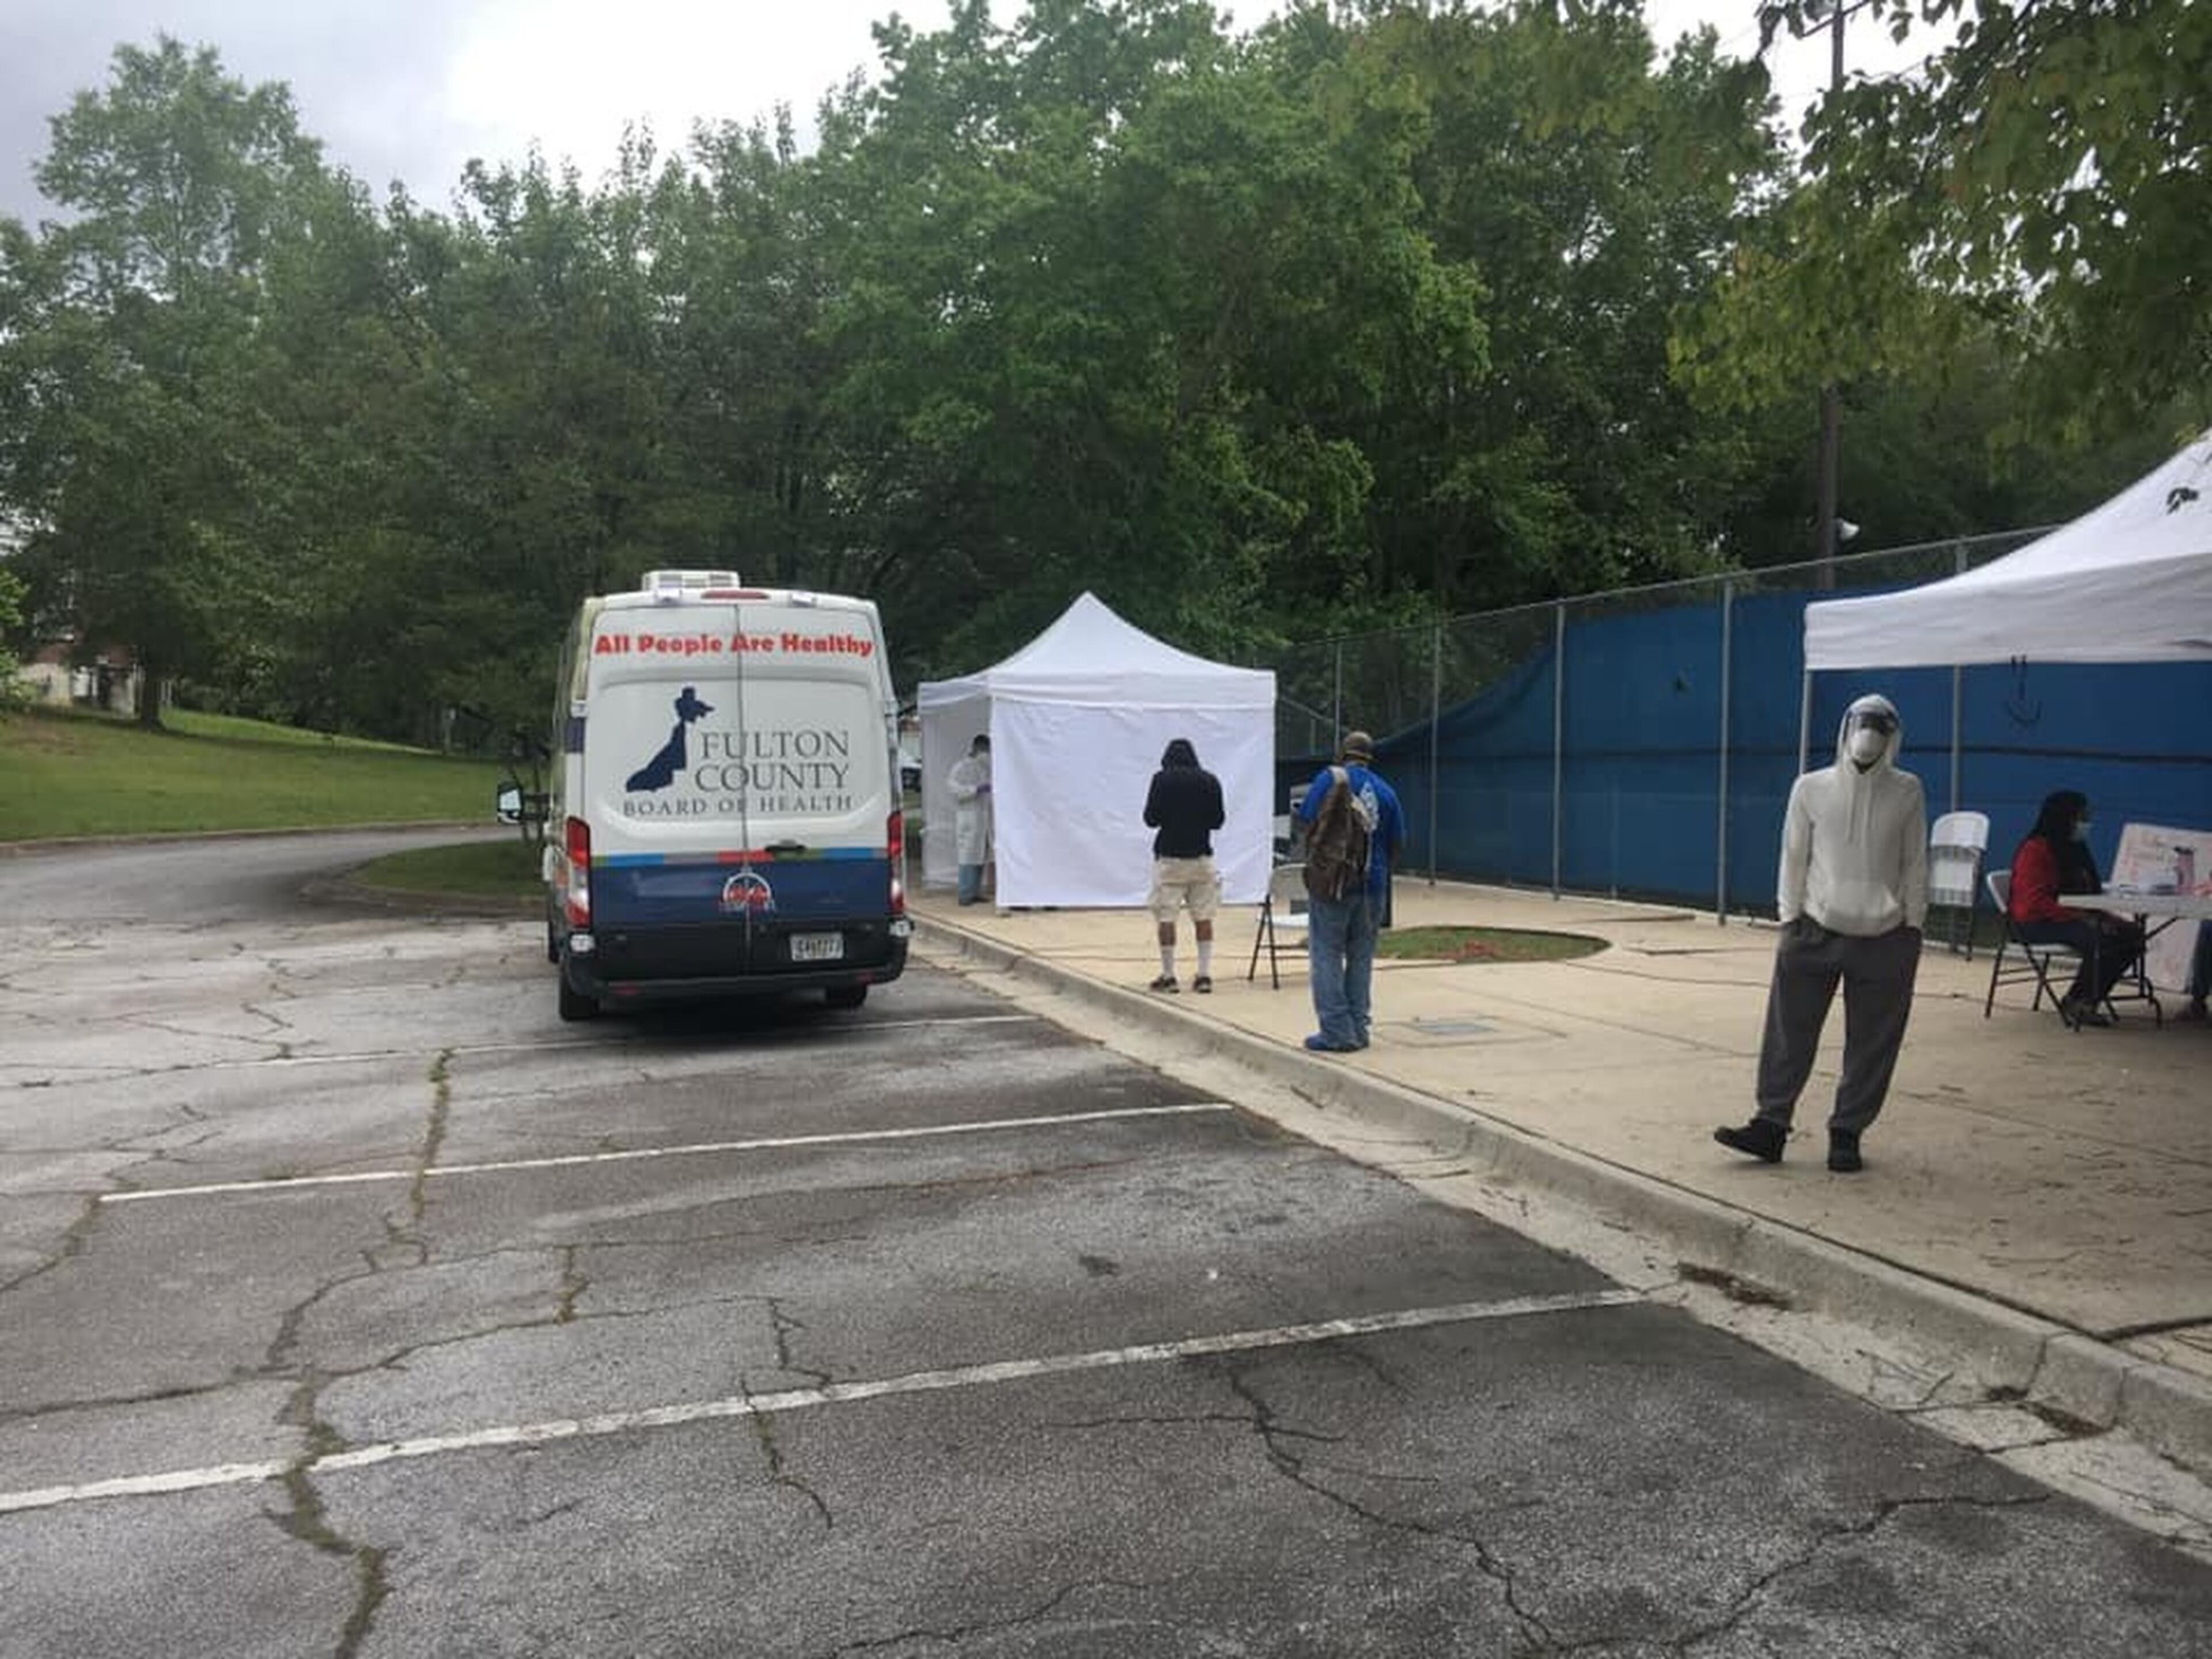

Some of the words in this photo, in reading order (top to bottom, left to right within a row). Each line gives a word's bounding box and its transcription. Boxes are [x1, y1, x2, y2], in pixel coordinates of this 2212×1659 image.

[595, 635, 630, 654] All
[638, 634, 722, 656] People
[730, 634, 774, 652] Are
[781, 633, 873, 657] Healthy
[700, 729, 849, 759] FULTON
[695, 763, 850, 793] COUNTY
[624, 798, 707, 817] BOARD
[718, 798, 745, 813] OF
[760, 796, 852, 812] HEALTH
